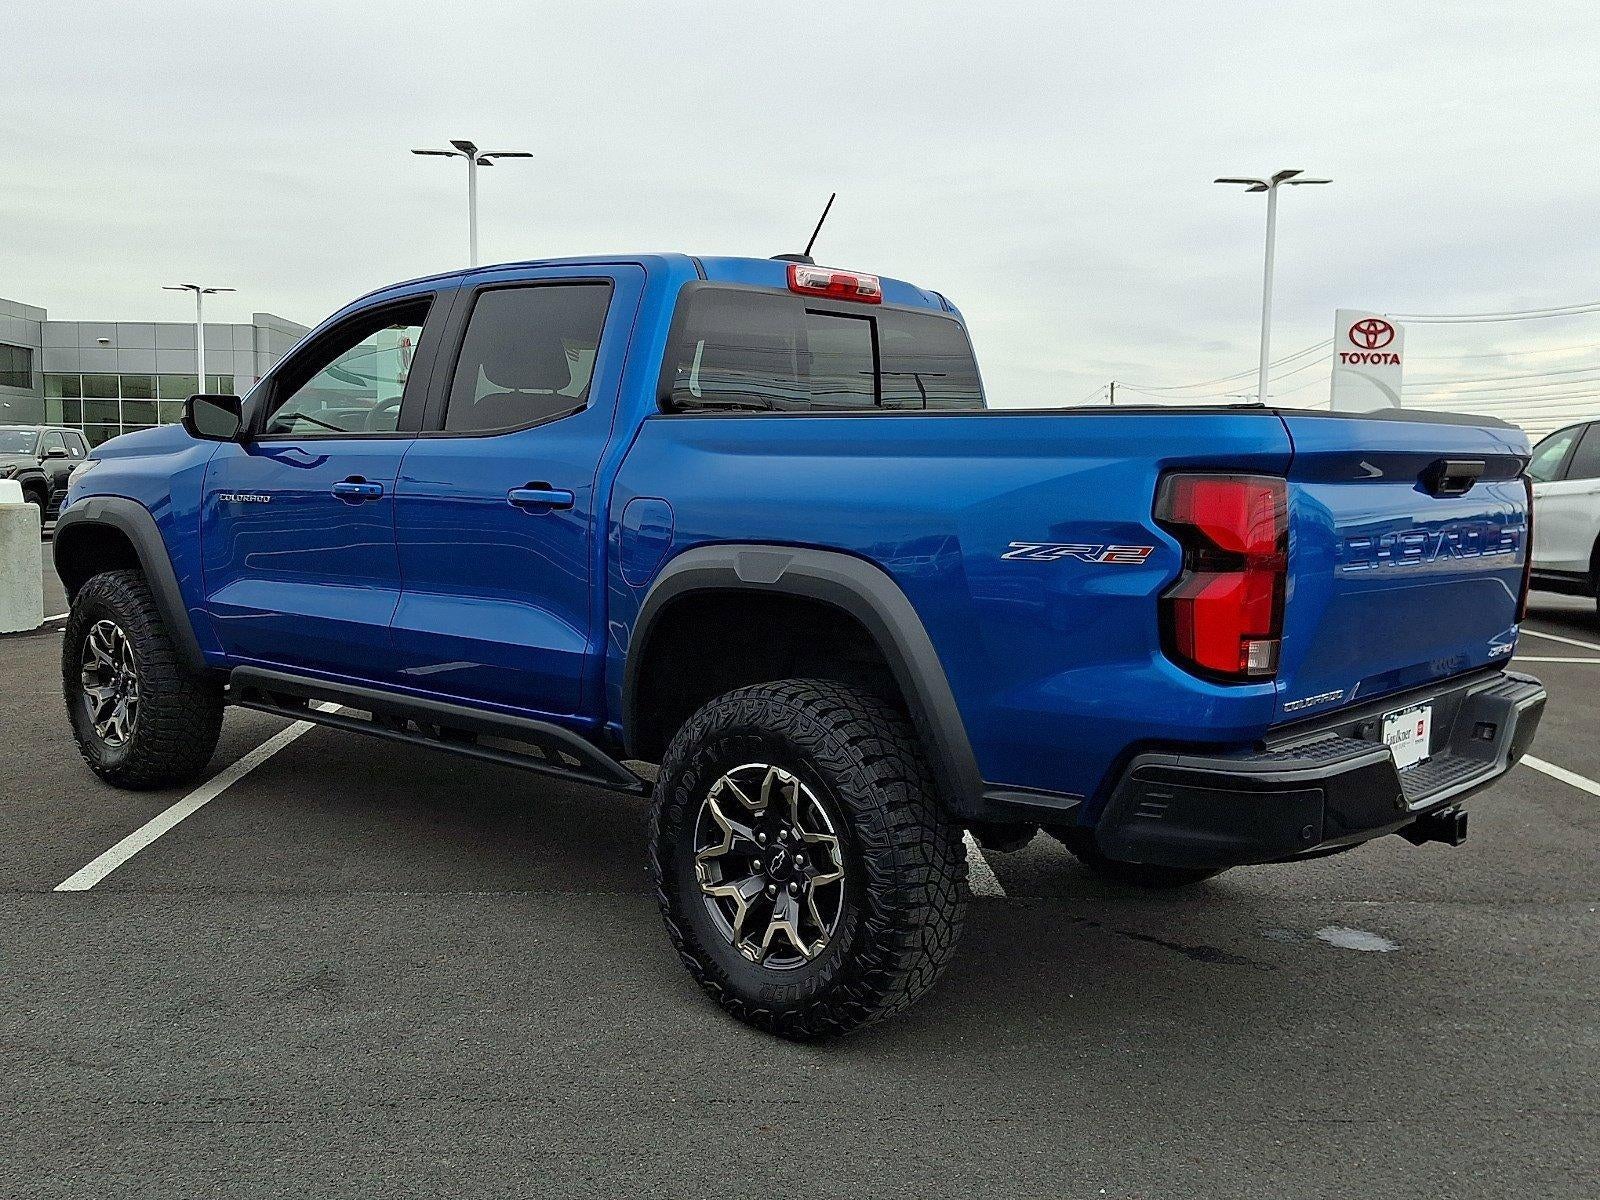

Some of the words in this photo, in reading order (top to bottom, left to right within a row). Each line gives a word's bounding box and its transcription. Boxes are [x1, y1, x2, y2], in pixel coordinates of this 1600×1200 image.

[1339, 352, 1401, 365] TOYOTA
[219, 493, 271, 503] COLORADO
[1000, 541, 1155, 565] ZR2
[1341, 524, 1527, 571] CHEVROLET
[1283, 689, 1344, 713] COLORADO
